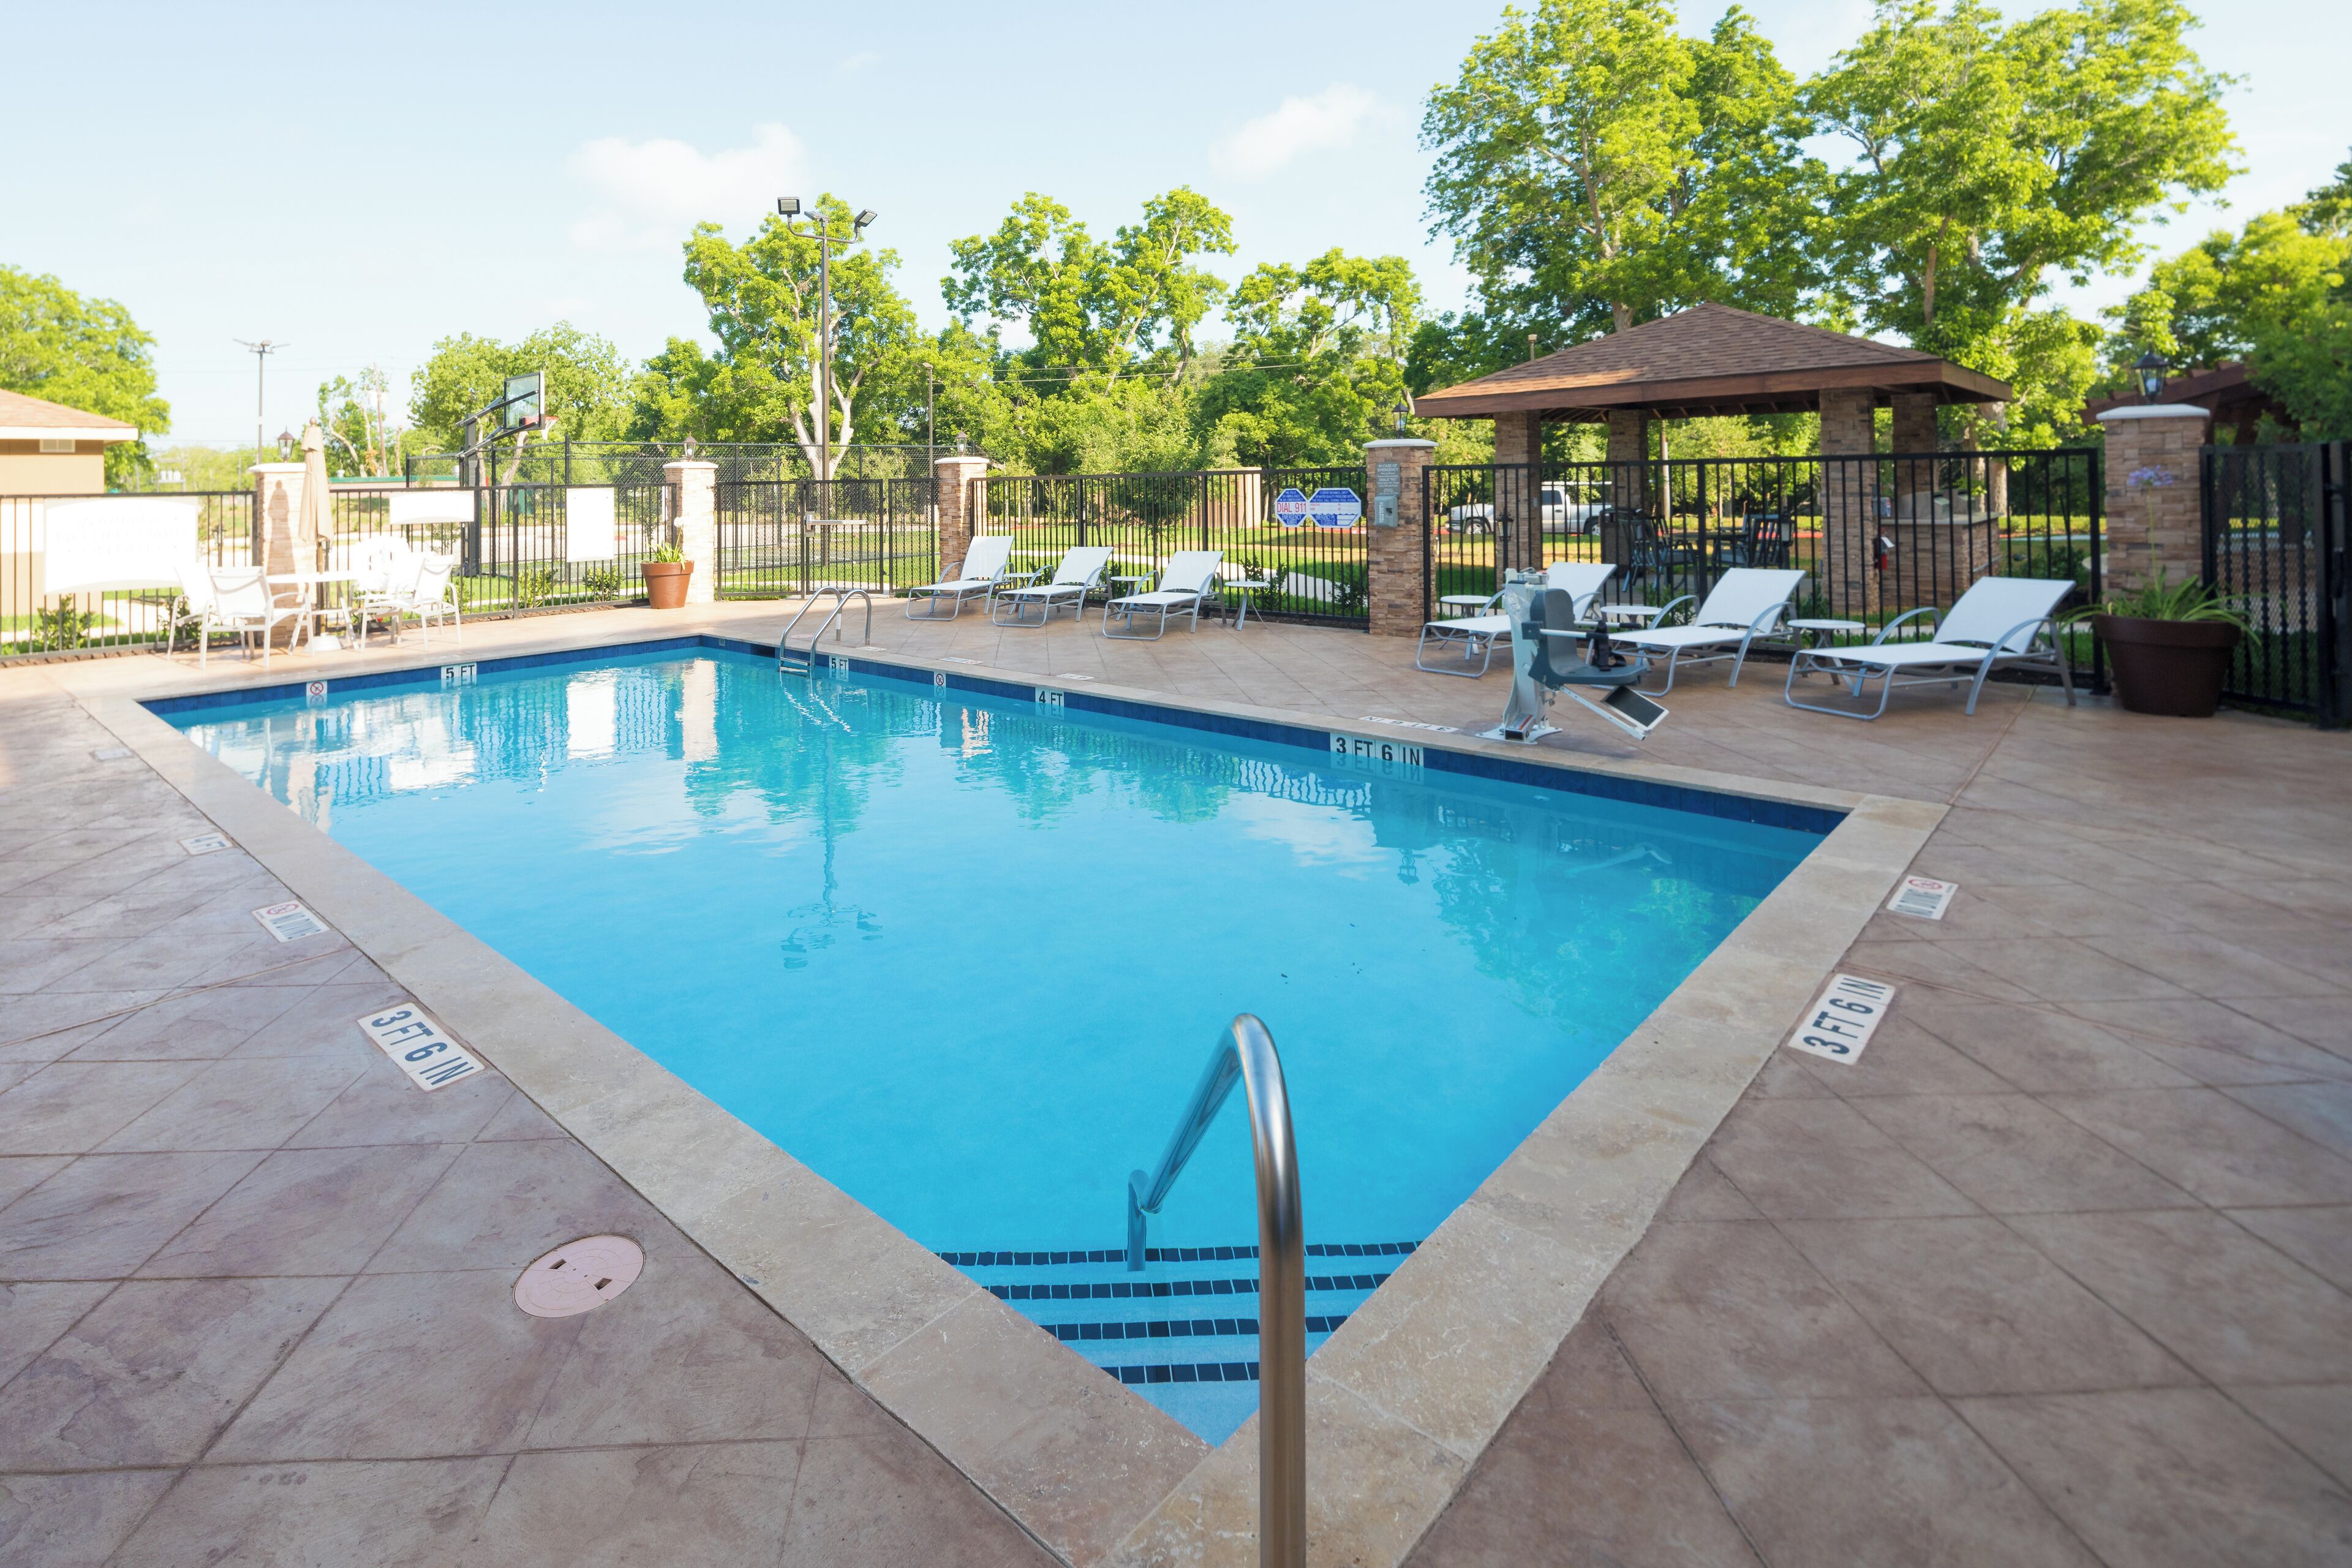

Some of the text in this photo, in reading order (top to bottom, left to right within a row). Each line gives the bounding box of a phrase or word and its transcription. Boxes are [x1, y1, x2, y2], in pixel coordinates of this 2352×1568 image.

[1276, 502, 1306, 513] DIAL 911
[831, 657, 848, 671] 5 FT
[446, 665, 475, 680] 5 FT
[1039, 690, 1063, 706] 4 FT
[1336, 737, 1420, 766] 3 FT 6 IN
[1803, 978, 1887, 1055] 3 FT 6 IN
[371, 1011, 475, 1085] 3 FT 6 IN
